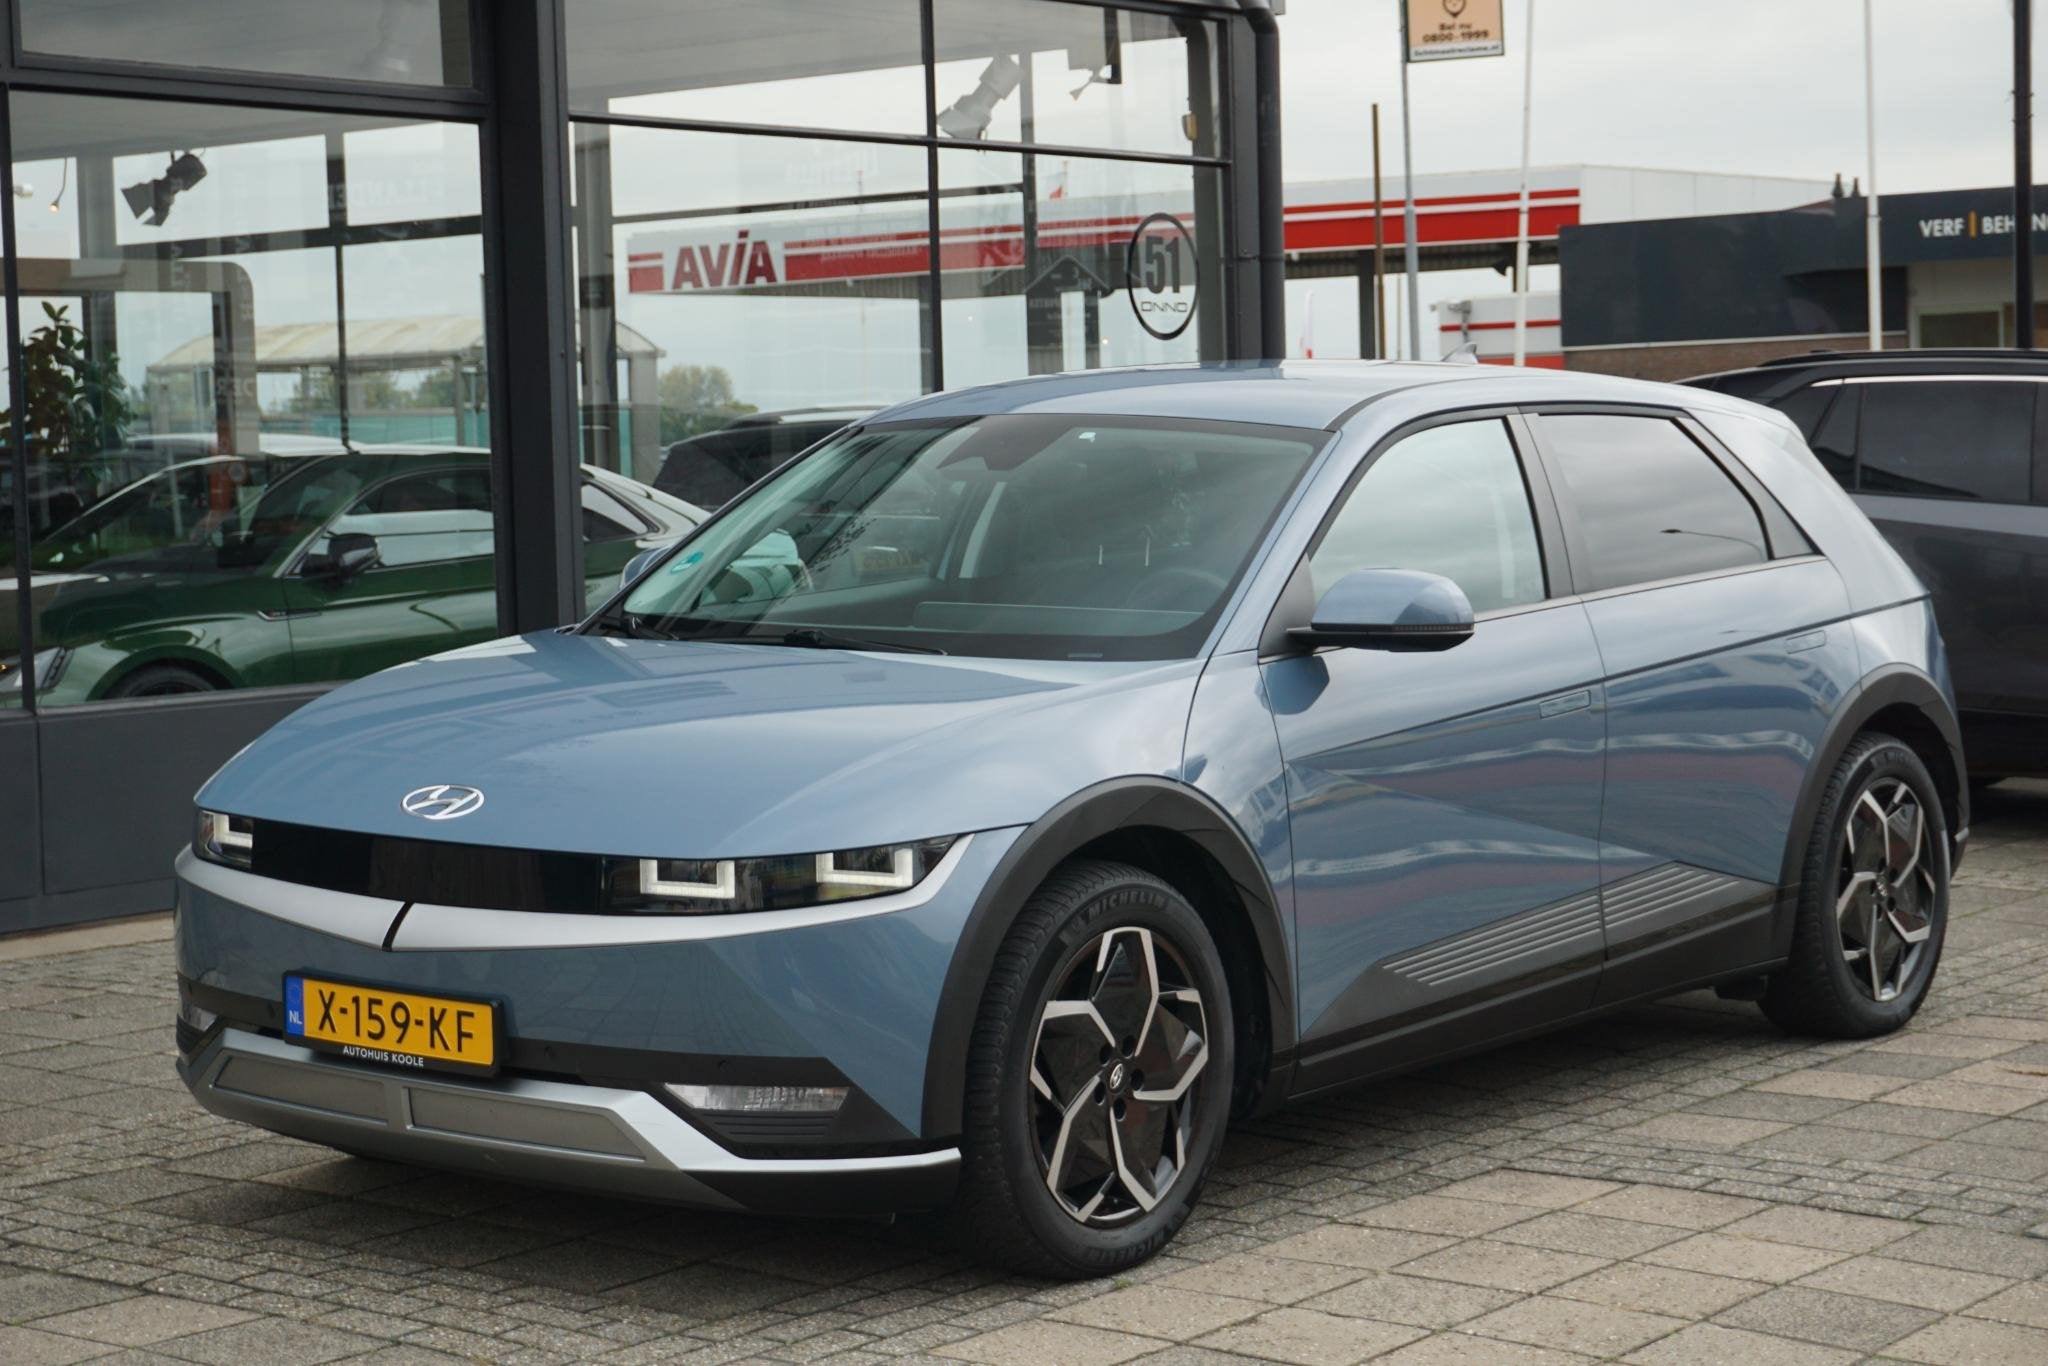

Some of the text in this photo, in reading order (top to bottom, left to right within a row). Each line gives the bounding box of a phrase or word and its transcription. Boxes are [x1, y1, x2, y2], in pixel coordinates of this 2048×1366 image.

[1919, 213, 2048, 238] VERF BEHN
[1145, 235, 1181, 295] 51
[1088, 891, 1166, 921] MICHELIN
[289, 1010, 303, 1025] NL
[318, 989, 475, 1053] X-159-KF
[342, 1045, 424, 1068] AUTOHUIS KOOLE
